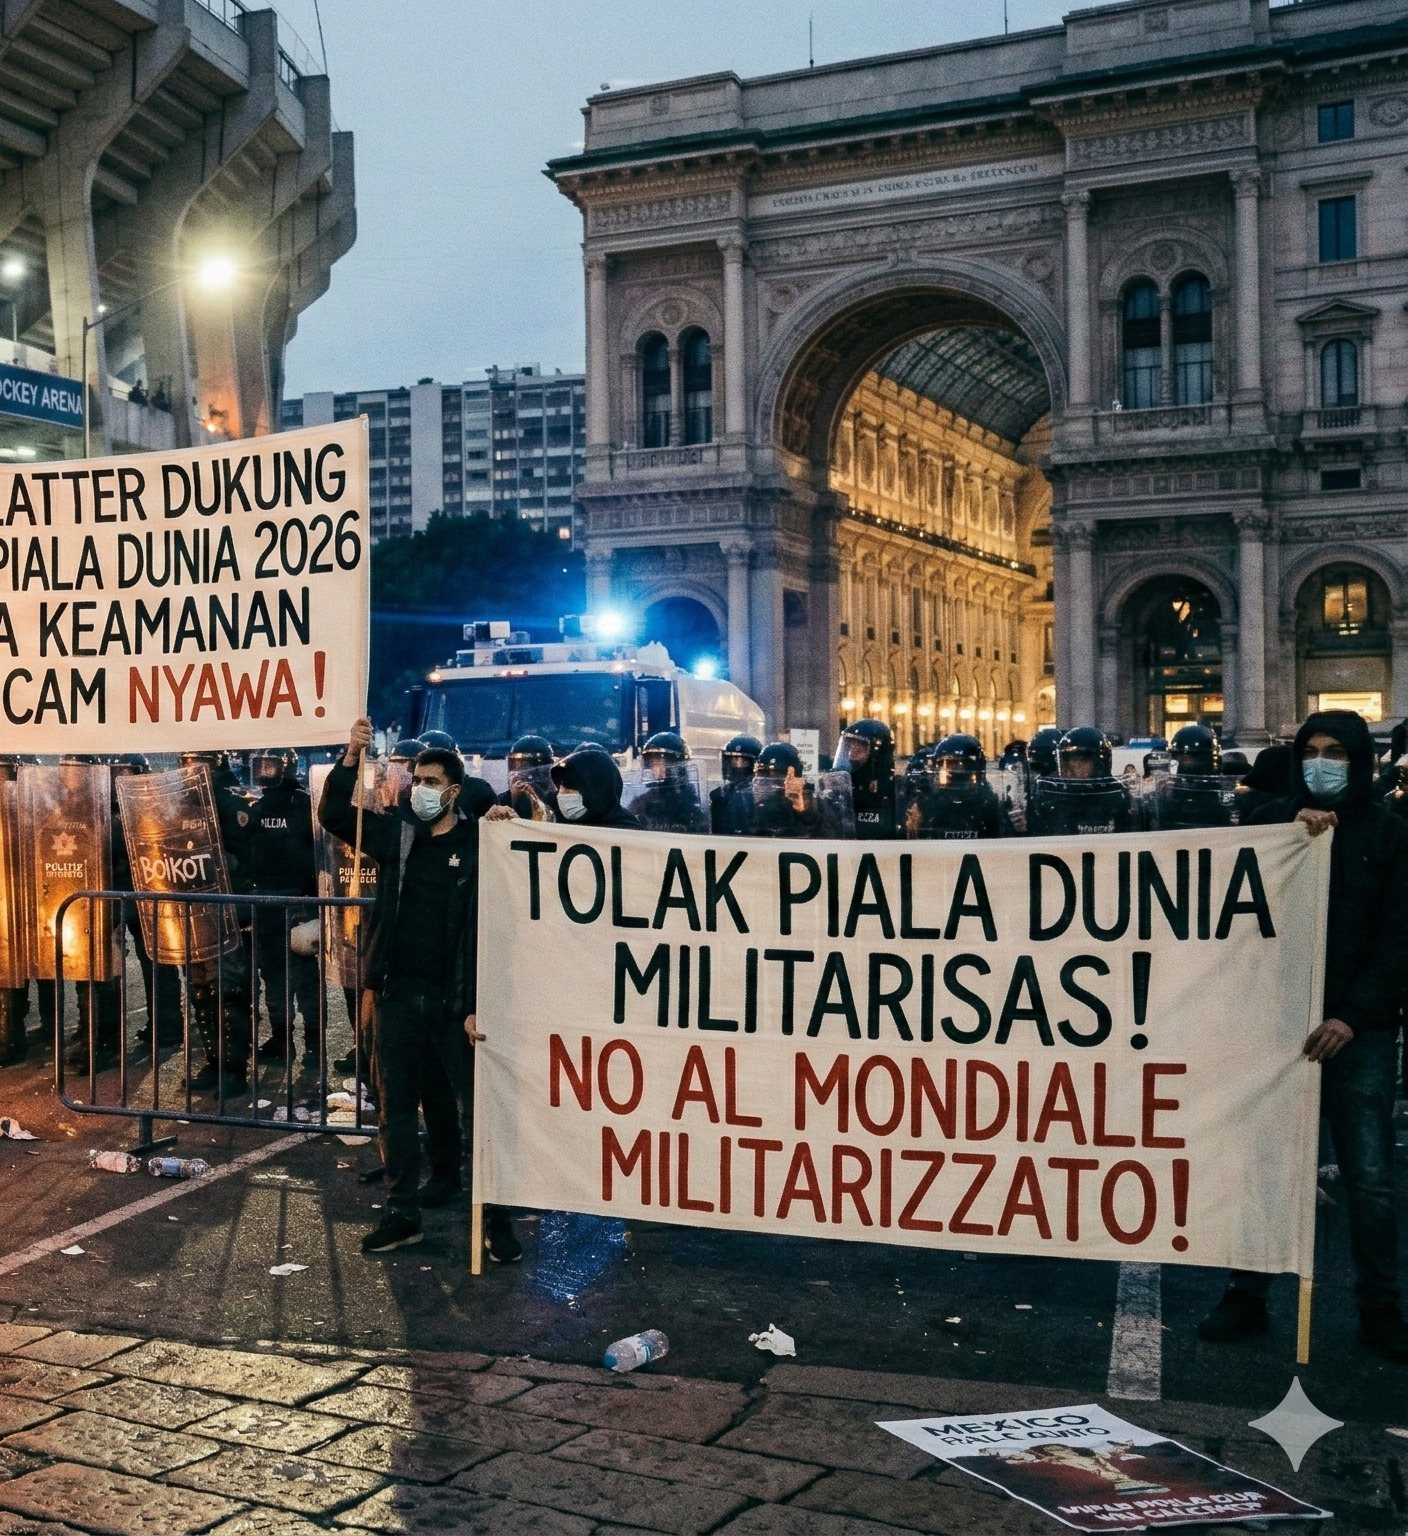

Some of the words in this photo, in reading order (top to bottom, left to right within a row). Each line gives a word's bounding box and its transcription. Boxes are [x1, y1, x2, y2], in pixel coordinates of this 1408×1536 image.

[41, 387, 83, 415] ARENA
[162, 443, 346, 519] DUKUNG
[117, 524, 241, 590] DUNIA
[254, 509, 362, 581] 2026
[39, 586, 311, 658] KEAMANAN
[510, 840, 750, 934] TOLAK
[779, 851, 998, 943] PIALA
[1028, 846, 1277, 943] DUNIA
[613, 941, 1150, 1051] MILITARISAS!
[548, 1033, 644, 1116] NO
[671, 1045, 763, 1129] AL
[794, 1052, 1188, 1150] MONDIALE
[601, 1128, 1190, 1253] MILITARIZZATO!
[921, 1414, 1090, 1437] MEXICO
